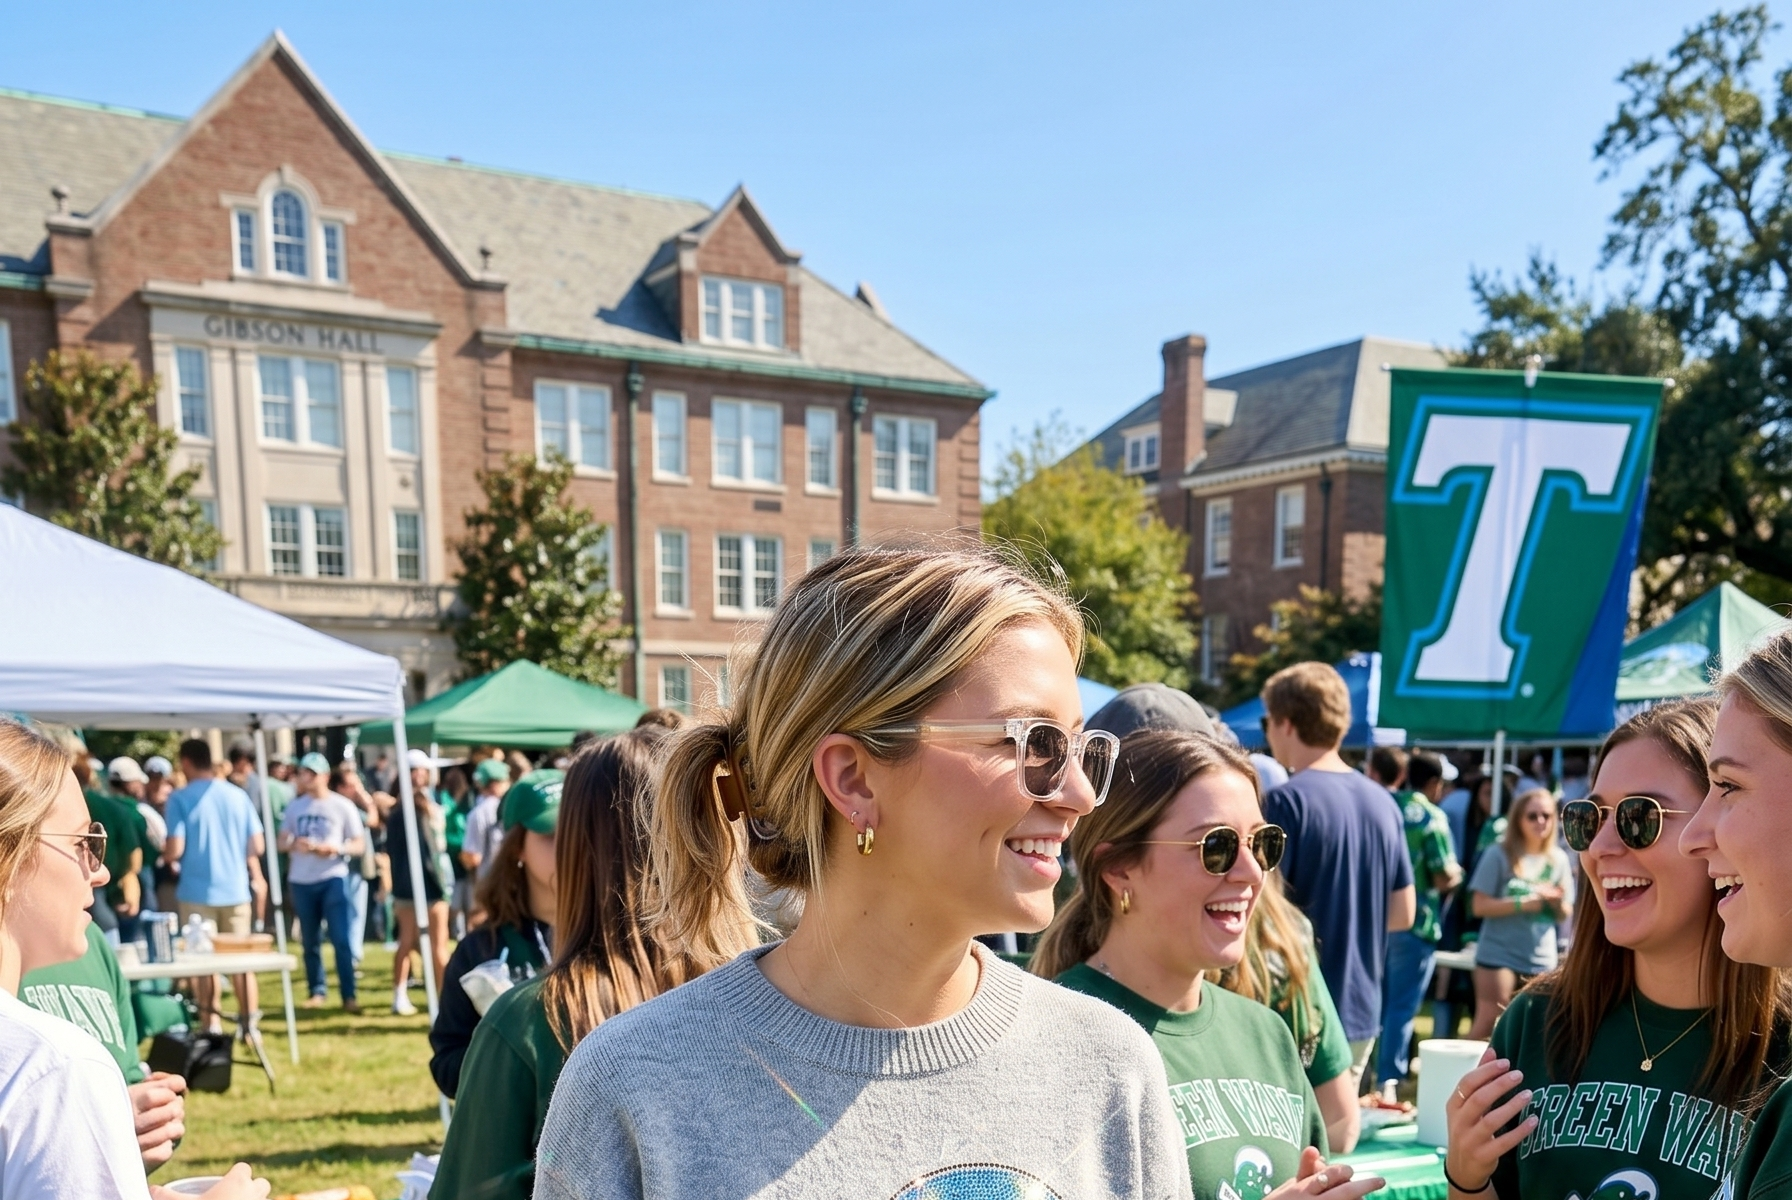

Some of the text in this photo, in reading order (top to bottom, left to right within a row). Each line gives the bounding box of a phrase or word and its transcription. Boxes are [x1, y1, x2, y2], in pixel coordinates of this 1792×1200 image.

[203, 314, 385, 354] GIBSON HALL
[1394, 396, 1653, 699] T
